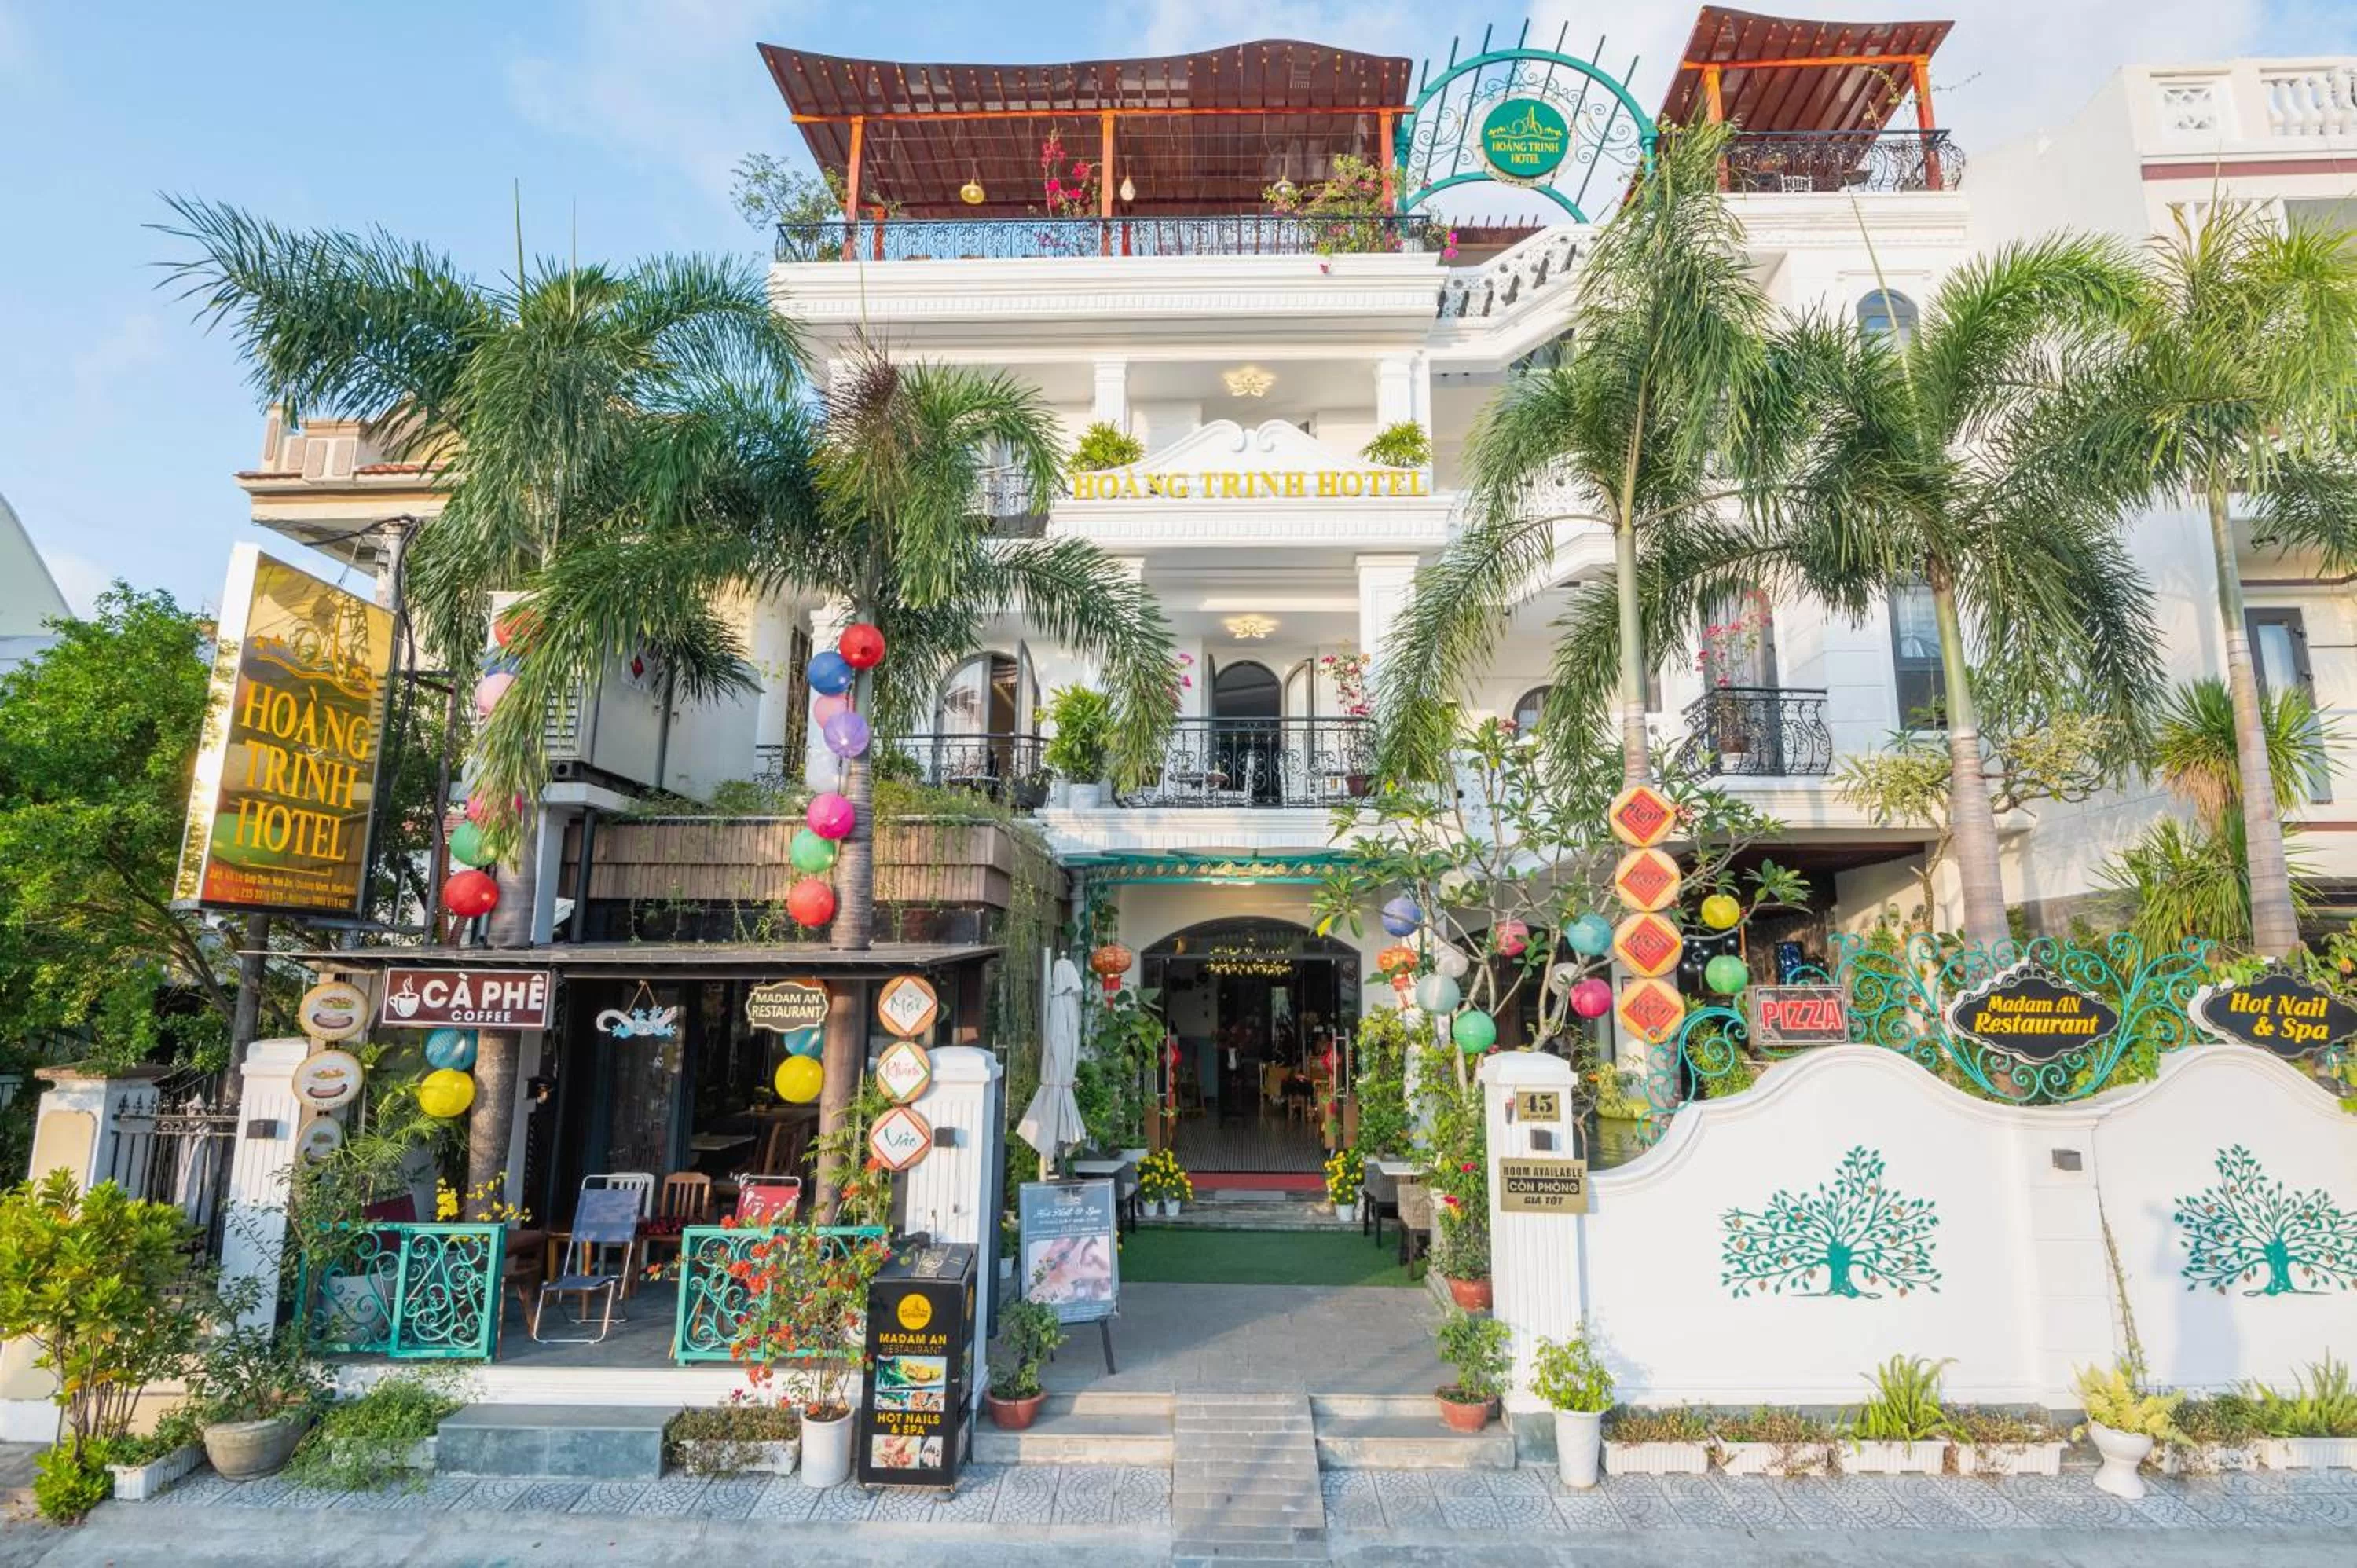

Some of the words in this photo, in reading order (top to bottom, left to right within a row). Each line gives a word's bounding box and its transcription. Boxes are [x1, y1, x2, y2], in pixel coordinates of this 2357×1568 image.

[1511, 153, 1540, 163] HOTEL
[1201, 471, 1307, 498] TRINH
[1316, 471, 1430, 498] HOTEL
[239, 680, 371, 760] HOÀNG
[244, 739, 358, 809] TRINH
[234, 797, 346, 863] HOTEL
[422, 972, 473, 1009] CÀ
[481, 973, 545, 1010] PHÊ
[755, 992, 801, 1003] MADAM
[803, 994, 819, 1003] AN
[752, 1005, 823, 1018] RESTAURANT
[1988, 995, 2053, 1013] Madam
[2230, 992, 2273, 1013] Hot
[2276, 995, 2329, 1017] Nail
[451, 1009, 511, 1022] COFFEE
[1761, 999, 1842, 1031] PIZZA
[1974, 1012, 2099, 1035] Restaurant
[2252, 1016, 2275, 1037] &
[2280, 1017, 2330, 1044] Spa
[1523, 1094, 1553, 1112] 45
[1503, 1165, 1530, 1176] ROOM
[1533, 1166, 1583, 1178] AVAILABLE
[1538, 1180, 1578, 1192] PHÒNG
[879, 1332, 926, 1344] MADAM
[929, 1334, 947, 1345] AN
[877, 1412, 903, 1423] HOT
[905, 1414, 940, 1425] NAILS
[890, 1423, 900, 1434] &
[903, 1424, 925, 1435] SPA
